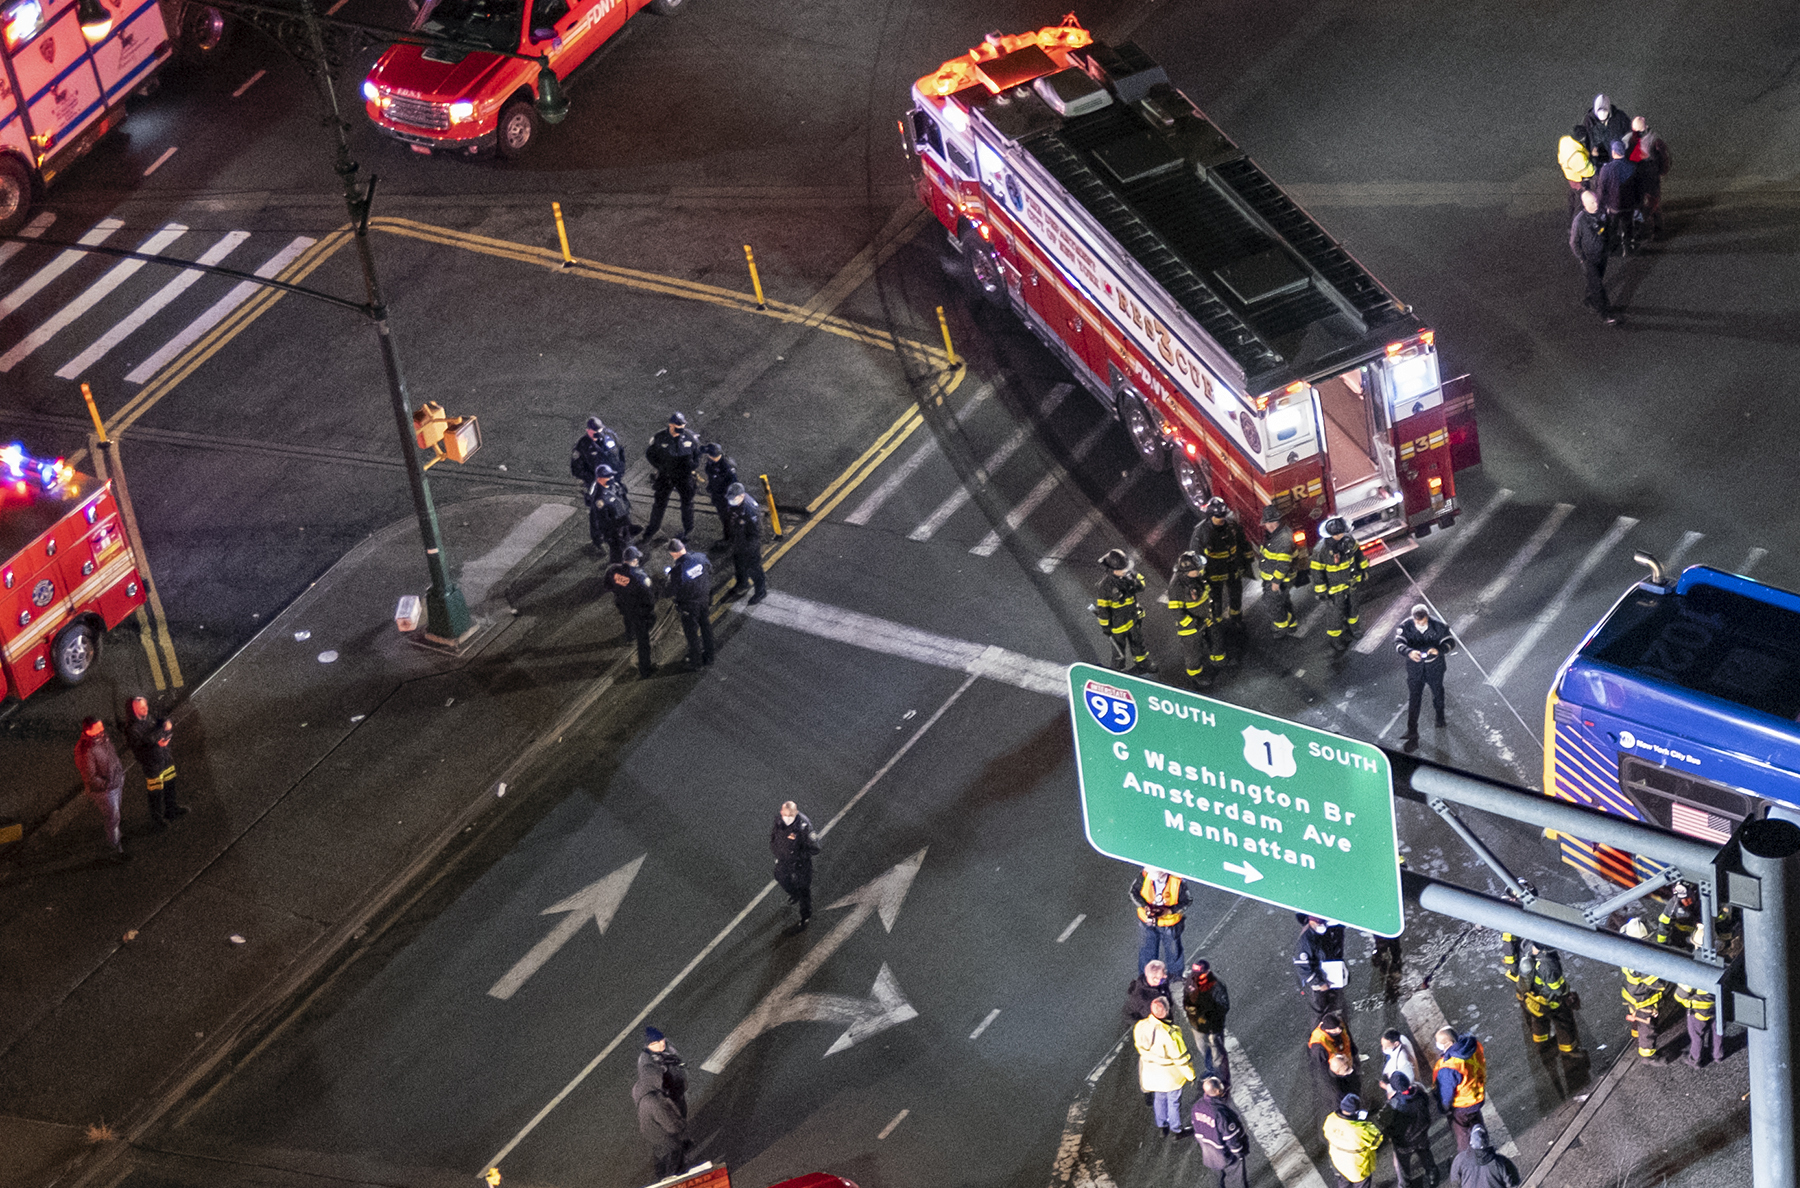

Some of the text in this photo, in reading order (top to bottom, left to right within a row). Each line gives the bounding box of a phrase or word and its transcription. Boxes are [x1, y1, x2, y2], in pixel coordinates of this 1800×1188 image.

[1415, 435, 1430, 452] 3
[1292, 484, 1308, 500] R
[1090, 683, 1128, 698] INTERSTATE
[1091, 696, 1131, 725] 95
[1148, 696, 1216, 727] SOUTH
[1263, 741, 1273, 766] 1
[1308, 741, 1377, 773] SOUTH
[1653, 745, 1669, 756] York
[1670, 750, 1685, 761] City
[1113, 741, 1356, 826] G Washington Br
[1122, 771, 1351, 852] Amsterdam Ave
[1164, 809, 1315, 870] Manhattan
